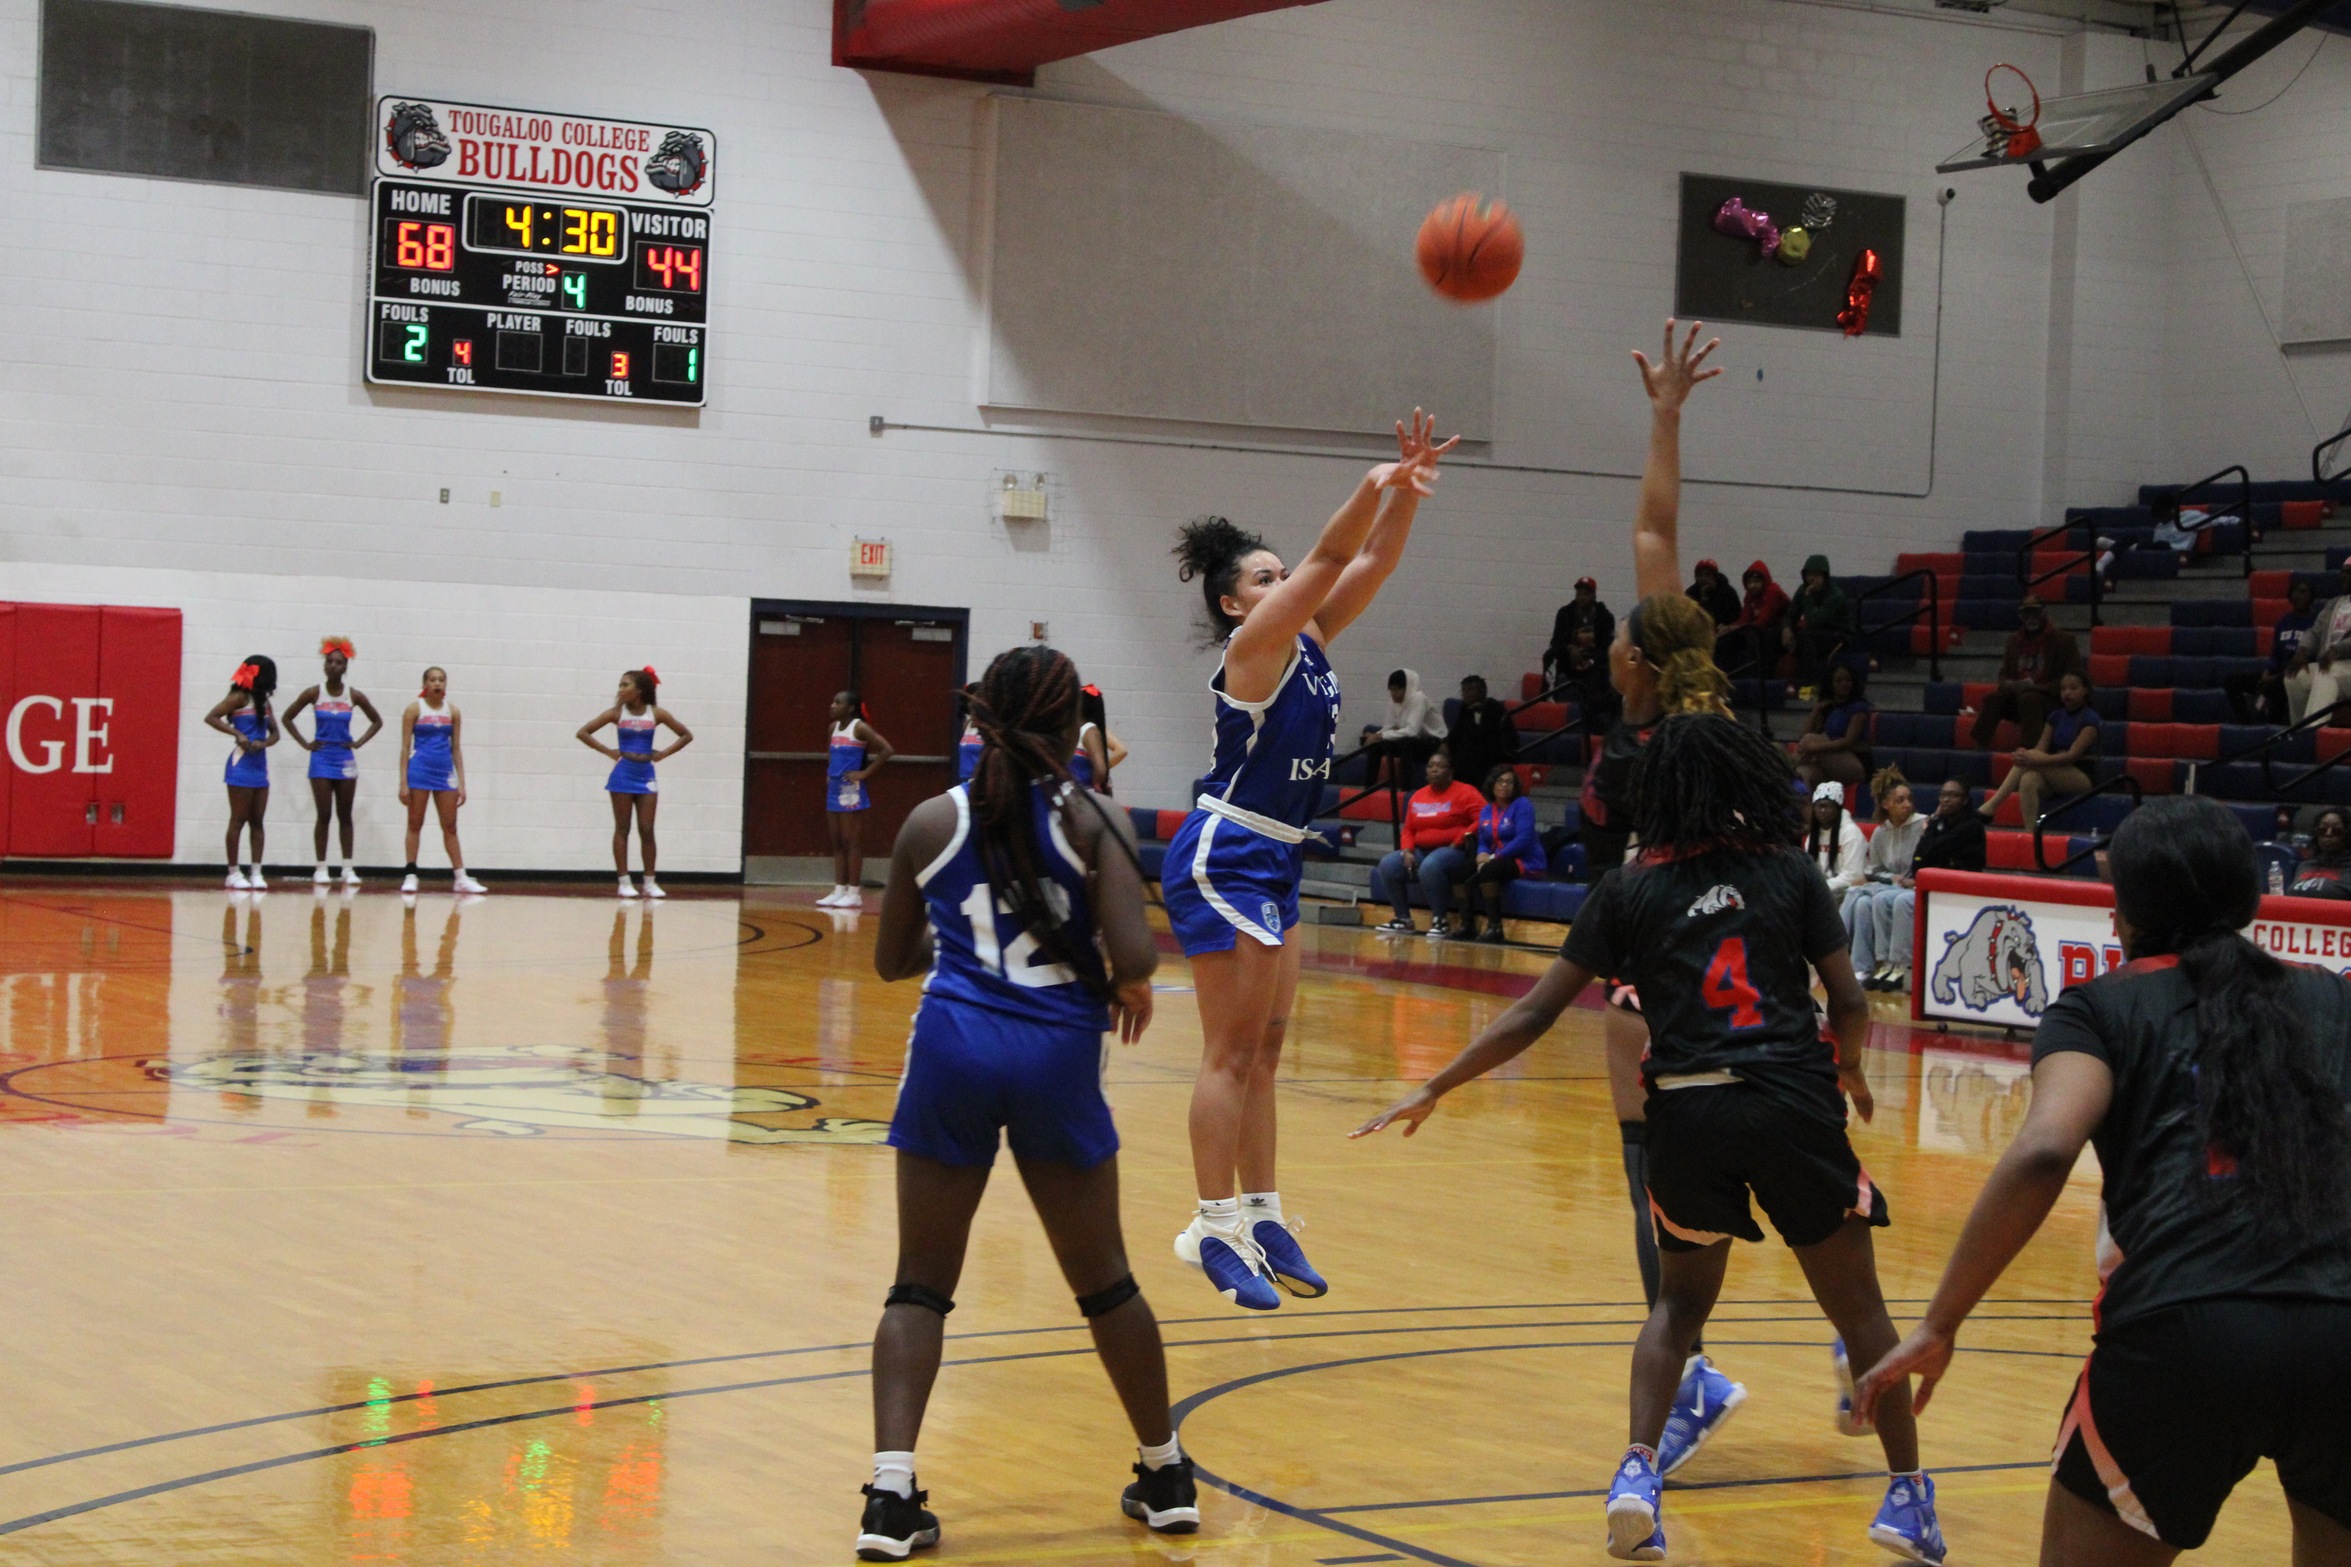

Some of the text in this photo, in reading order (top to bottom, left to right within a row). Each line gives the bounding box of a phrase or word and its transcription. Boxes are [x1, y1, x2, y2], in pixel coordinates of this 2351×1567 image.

[448, 109, 650, 152] TOUGALOO COLLEGE
[457, 138, 639, 193] BULLDOGS
[391, 190, 451, 215] HOME
[505, 205, 616, 256] 4:30
[631, 212, 707, 239] VISITOR
[397, 221, 454, 271] 68
[515, 260, 544, 274] POSS
[647, 246, 700, 291] 44
[410, 277, 461, 296] BONUS
[502, 273, 556, 293] PERIOD
[563, 274, 585, 309] 4
[381, 304, 429, 322] FOULS
[625, 295, 673, 314] BONUS
[487, 312, 541, 332] PLAYER
[565, 319, 611, 338] FOULS
[404, 324, 427, 362] 2
[653, 326, 698, 344] FOULS
[454, 341, 471, 365] 4
[612, 353, 628, 378] 3
[687, 347, 698, 382] 1
[447, 367, 475, 385] TOL
[605, 379, 632, 396] TOL
[860, 543, 886, 566] EXIT
[5, 694, 114, 774] GE
[959, 876, 1078, 988] 12
[1701, 936, 1766, 1031] 4
